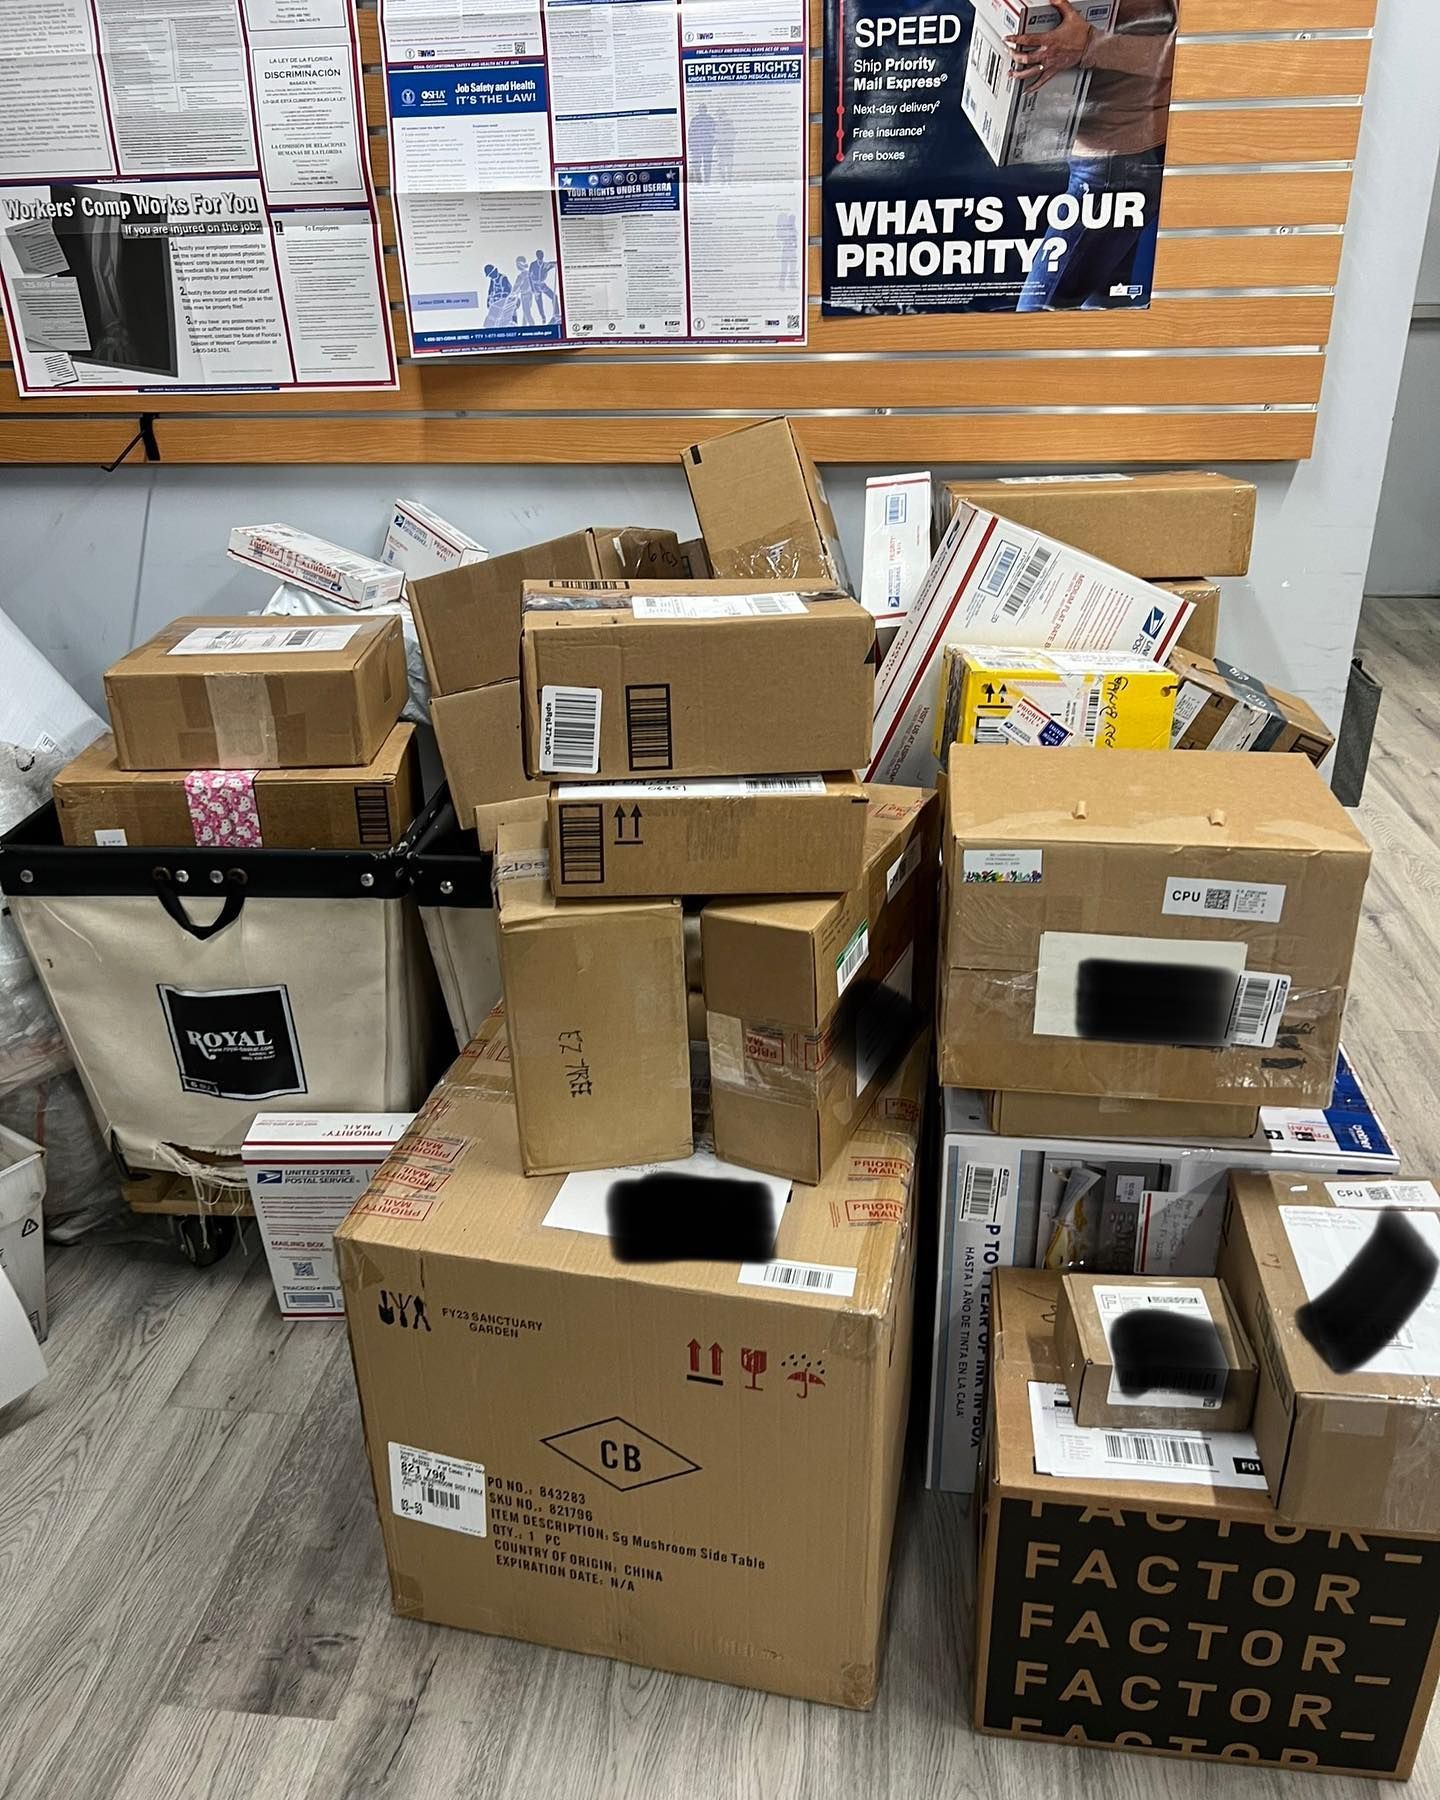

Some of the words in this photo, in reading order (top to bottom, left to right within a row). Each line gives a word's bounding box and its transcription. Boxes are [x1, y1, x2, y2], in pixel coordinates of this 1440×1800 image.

[854, 15, 961, 48] SPEED
[264, 68, 341, 79] DISCRIMINACIÓN
[687, 62, 751, 76] EMPLOYEE
[753, 60, 799, 73] RIGHTS
[854, 60, 882, 74] Ship
[885, 57, 936, 73] Priority
[455, 83, 469, 93] Job
[470, 82, 494, 94] Safety
[494, 81, 509, 92] and
[510, 80, 536, 91] Health
[853, 77, 883, 92] Mail
[456, 95, 477, 105] IT'S
[480, 95, 503, 104] THE
[505, 93, 536, 103] LAW!
[853, 103, 897, 116] Next-day
[853, 127, 874, 138] Free
[852, 150, 874, 161] Free
[876, 150, 905, 161] boxes
[567, 188, 587, 197] YOUR
[588, 187, 615, 196] RIGHTS
[617, 185, 642, 194] UNDER
[643, 182, 672, 192] USERRA
[3, 196, 76, 220] Workers'
[81, 196, 132, 220] Comp
[133, 194, 190, 217] Works
[191, 193, 222, 215] For
[221, 192, 259, 214] You
[835, 196, 1004, 237] WHAT'S
[1017, 191, 1146, 233] YOUR
[125, 225, 132, 236] If
[133, 226, 152, 238] you
[152, 226, 168, 236] are
[170, 223, 205, 236] injured
[207, 224, 220, 233] on
[222, 222, 239, 232] the
[240, 222, 260, 234] job:
[836, 237, 1067, 279] PRIORITY?
[1068, 573, 1086, 605] MEDIUM
[1059, 605, 1071, 625] FLAT
[1051, 623, 1062, 642] RATE
[1016, 702, 1046, 726] PRIORITY
[1172, 890, 1201, 902] CPU
[186, 1030, 273, 1060] ROYAL
[744, 1044, 777, 1059] PRIO
[396, 1144, 450, 1159] PRIORITY
[415, 1139, 443, 1149] MAIL
[403, 1167, 431, 1178] MAIL
[854, 1159, 909, 1172] PRIORITY
[1337, 1189, 1363, 1198] CPU
[362, 1203, 421, 1217] PRIORITY
[382, 1198, 412, 1208] MAIL
[853, 1202, 904, 1214] PRIORIT
[868, 1210, 898, 1219] MAIL
[986, 1224, 1001, 1236] P
[983, 1240, 1000, 1264] TO
[964, 1247, 975, 1280] HASTA
[961, 1290, 974, 1312] AÑO
[441, 1306, 470, 1322] FY23
[471, 1311, 543, 1331] SANCTUARY
[961, 1315, 971, 1328] DE
[469, 1321, 519, 1338] GARDEN
[959, 1331, 969, 1359] TINTA
[958, 1362, 967, 1374] EN
[957, 1377, 967, 1389] LA
[600, 1440, 643, 1473] CB
[1241, 1462, 1261, 1471] F01
[487, 1476, 503, 1490] PO
[539, 1487, 586, 1505] 843283
[489, 1492, 508, 1507] SKU
[549, 1503, 593, 1521] 821796
[491, 1508, 519, 1525] ITEM
[522, 1513, 609, 1541] DESCRIPTION:
[612, 1531, 629, 1547] Sg
[632, 1535, 697, 1559] Mushroom
[700, 1543, 727, 1562] Side
[730, 1549, 766, 1570] Table
[529, 1529, 534, 1541] 1
[545, 1532, 561, 1546] PC
[494, 1539, 548, 1561] COUNTRY
[550, 1546, 566, 1562] OF
[569, 1549, 618, 1572] ORIGIN:
[624, 1564, 664, 1582] CHINA
[496, 1555, 566, 1578] EXPIRATION
[569, 1567, 604, 1585] DATE:
[610, 1576, 636, 1592] N/A
